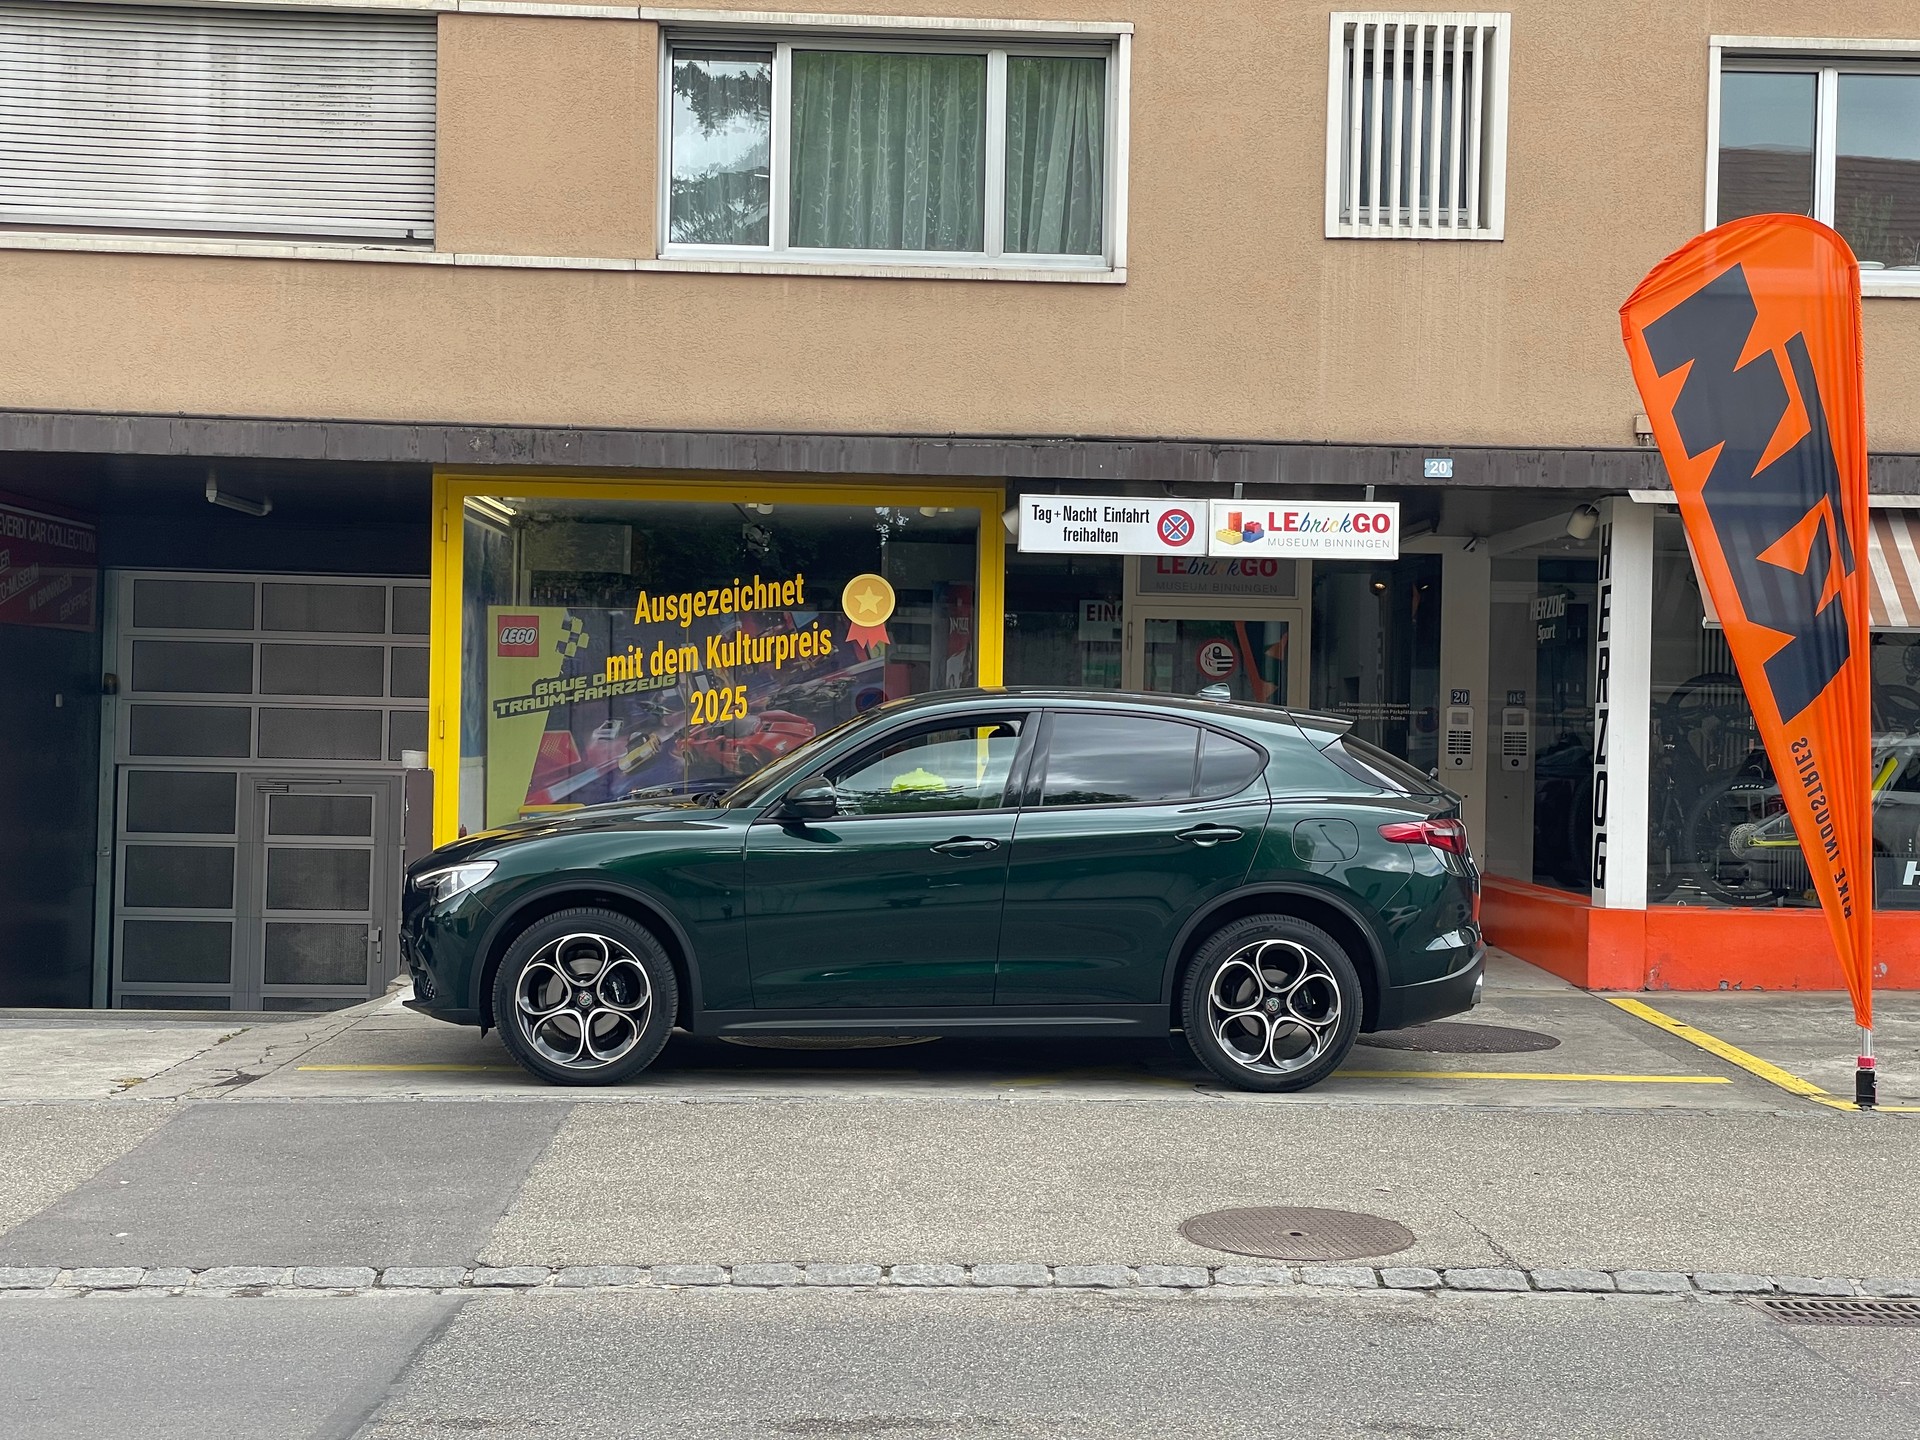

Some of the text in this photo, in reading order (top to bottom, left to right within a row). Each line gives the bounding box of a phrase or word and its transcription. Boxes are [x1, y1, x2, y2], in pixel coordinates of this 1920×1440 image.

[1429, 460, 1448, 474] 20
[1103, 506, 1150, 524] Einfahrt
[1268, 511, 1391, 533] LEbrickGO
[29, 520, 46, 543] CAR
[48, 524, 96, 553] COLLECTION
[1063, 527, 1119, 543] freihalten
[1267, 538, 1390, 548] MUSEUM BINNINGEN
[1156, 581, 1278, 593] MUSEUM BINNINGEN
[634, 573, 805, 628] Ausgezeichnet
[1530, 594, 1566, 621] HERZOG
[500, 627, 537, 645] LEGO
[1537, 624, 1556, 644] Sport
[606, 644, 644, 684] mit
[650, 640, 699, 676] dem
[706, 621, 832, 670] Kulturpreis
[496, 674, 677, 715] TRAUM-FAHRZEUG
[535, 676, 588, 696] BAUE
[690, 685, 748, 725] 2025
[1453, 691, 1468, 703] 20
[1594, 522, 1612, 890] HERZOG
